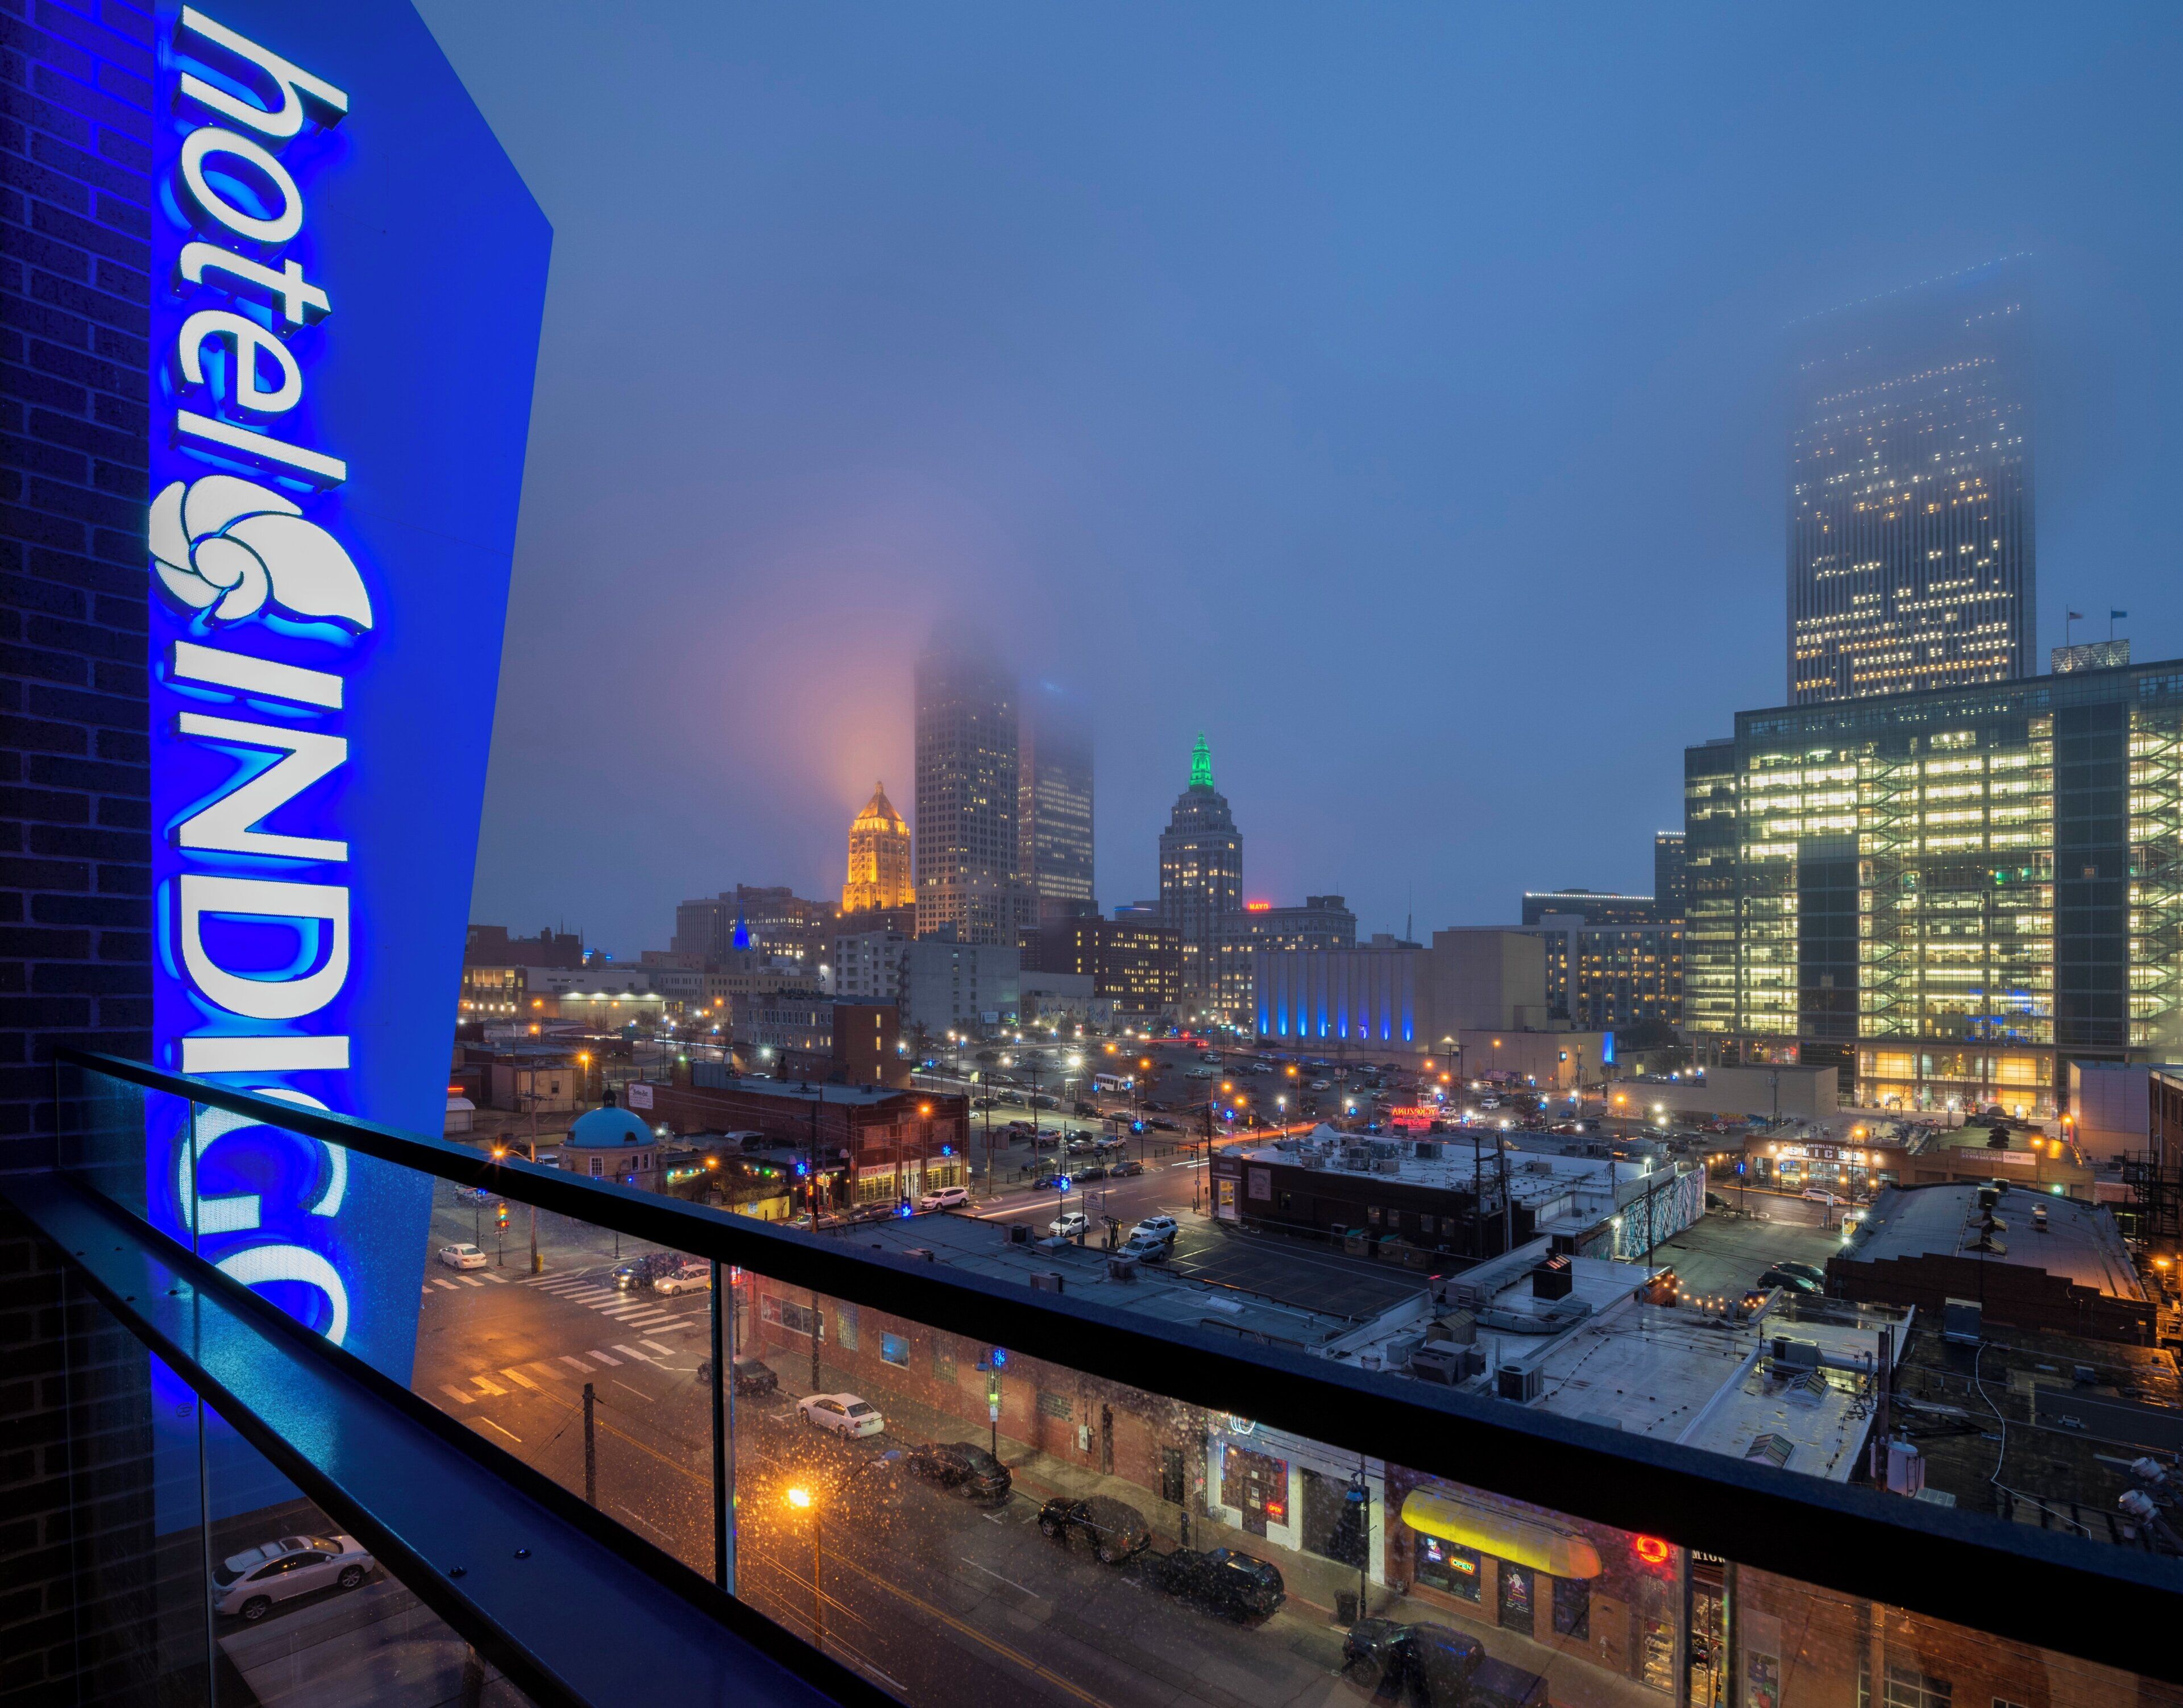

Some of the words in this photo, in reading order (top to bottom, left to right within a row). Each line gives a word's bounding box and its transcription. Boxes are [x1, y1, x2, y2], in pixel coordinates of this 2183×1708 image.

[177, 4, 349, 481] hotel
[1788, 1146, 1862, 1161] SLICED
[1269, 1504, 1281, 1513] OPEN
[1452, 1559, 1472, 1571] OPEN
